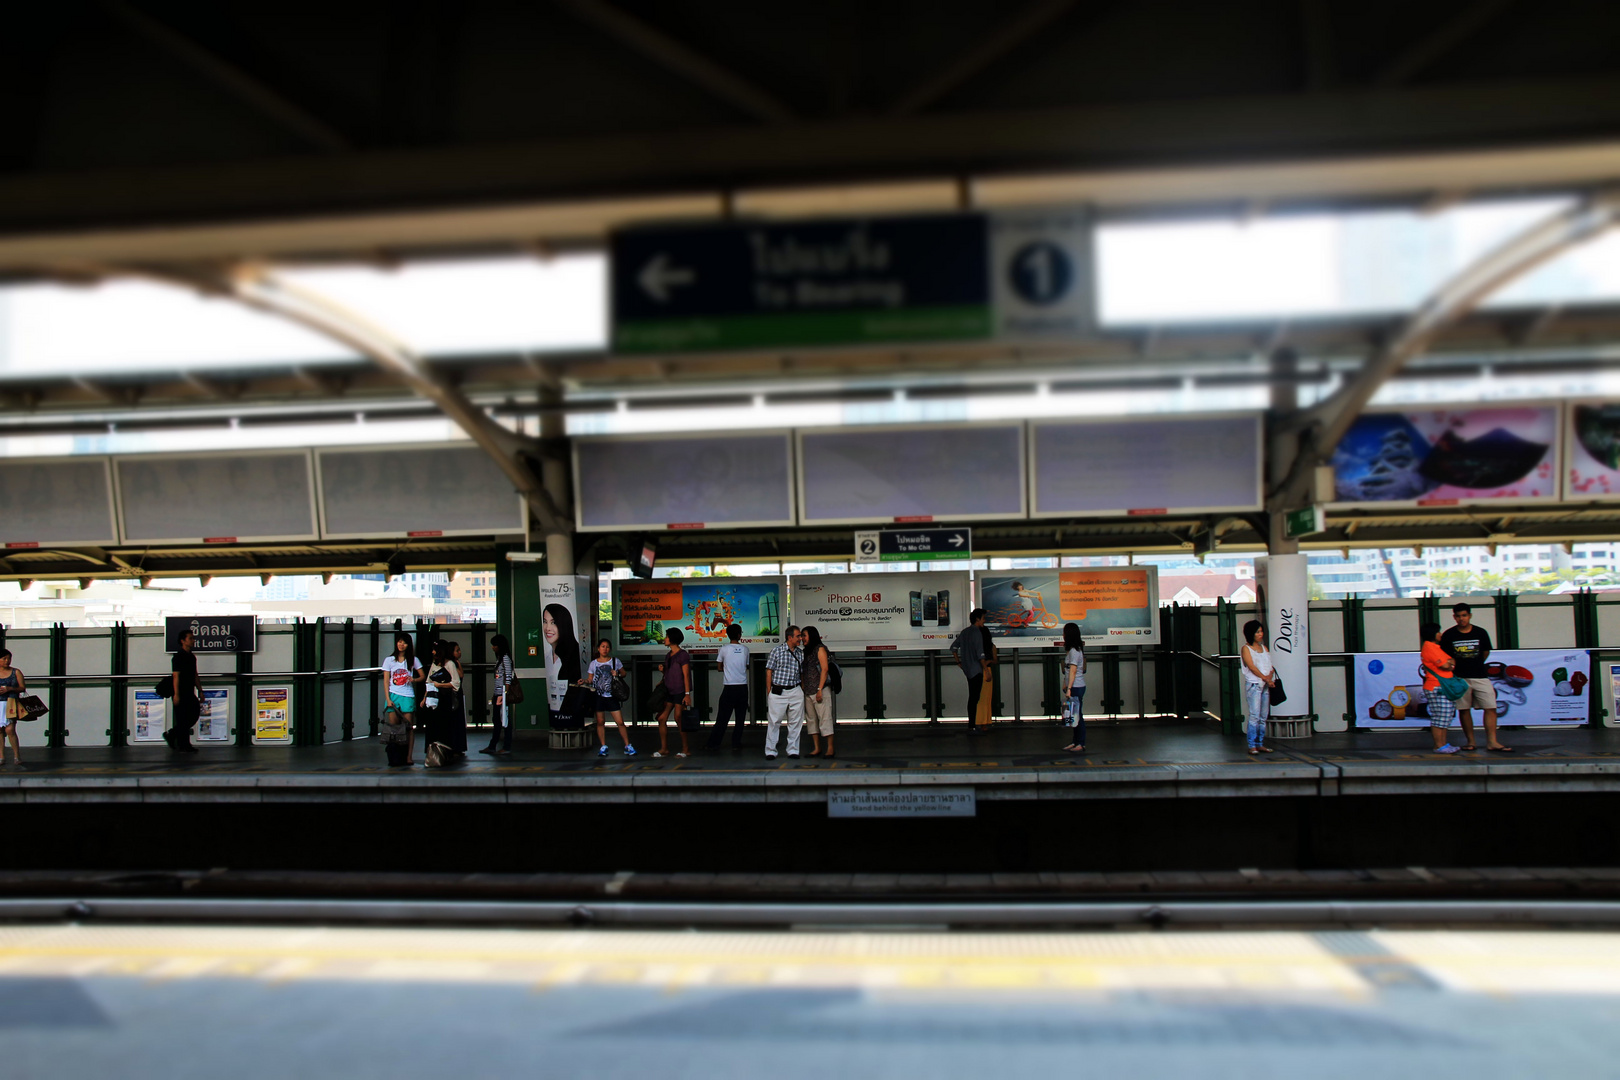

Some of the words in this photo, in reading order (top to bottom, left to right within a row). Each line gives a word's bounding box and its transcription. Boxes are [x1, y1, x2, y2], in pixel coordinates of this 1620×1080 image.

[1024, 247, 1057, 300] 1
[896, 534, 931, 544] ไปหมอชิต
[863, 541, 873, 553] 2
[557, 583, 569, 593] 75
[827, 593, 863, 604] iPhone
[190, 619, 231, 636] ชิดลม
[1274, 608, 1293, 654] Dove
[202, 639, 222, 648] Lom
[226, 639, 236, 647] E1
[851, 804, 872, 812] Stand
[873, 804, 898, 812] behind
[914, 803, 937, 812] yellow
[938, 803, 952, 811] line
